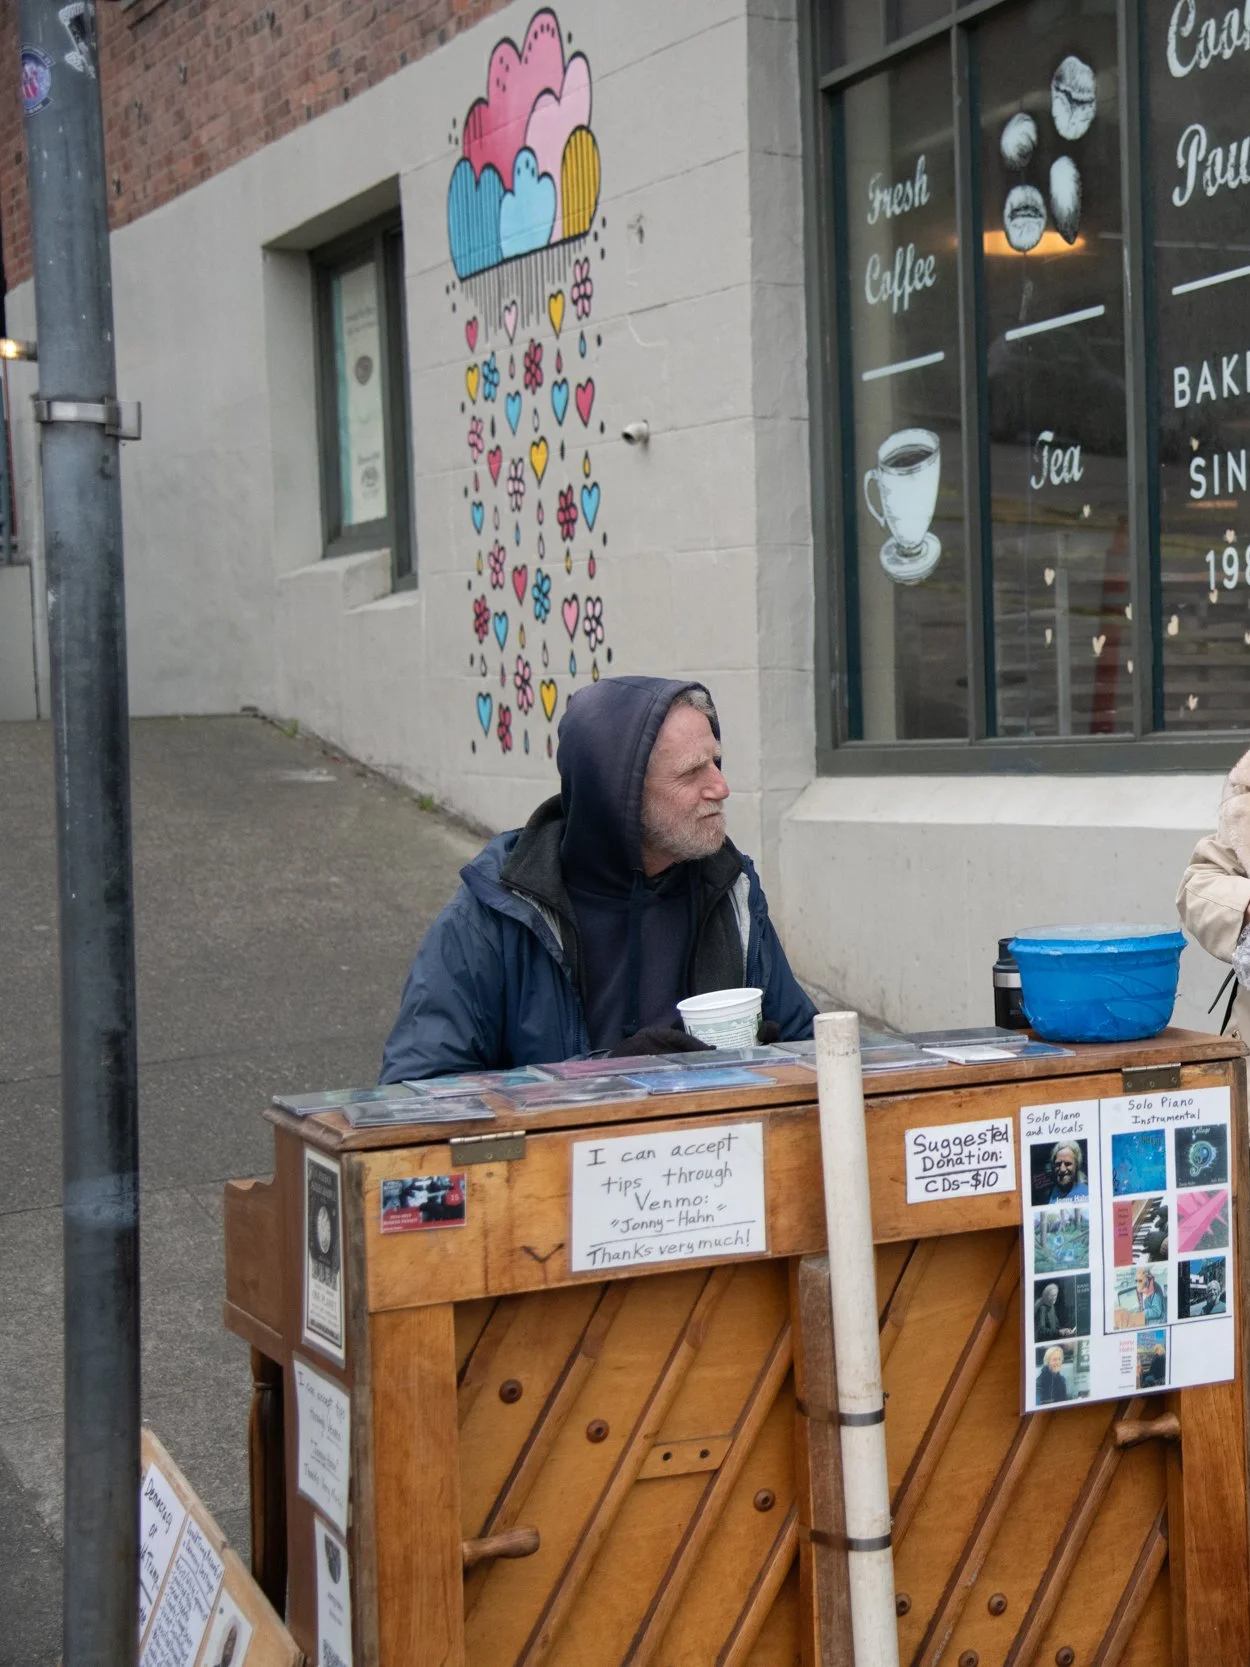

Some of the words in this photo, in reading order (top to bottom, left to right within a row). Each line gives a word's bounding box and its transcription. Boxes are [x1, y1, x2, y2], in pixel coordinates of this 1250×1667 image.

[867, 154, 930, 225] Fresh
[865, 243, 936, 313] Coffee
[1029, 430, 1083, 490] Tea
[1026, 1112, 1050, 1124] Solo
[1055, 1109, 1081, 1121] Piano
[1128, 1098, 1153, 1111] Solo
[1161, 1096, 1194, 1108] Piano
[1132, 1109, 1200, 1125] Instrumental
[913, 1123, 1009, 1159] Suggested
[1026, 1126, 1043, 1137] and
[1049, 1120, 1083, 1134] Vocals
[587, 1148, 606, 1167] I
[621, 1149, 656, 1162] can
[671, 1133, 739, 1161] accept
[922, 1147, 1002, 1172] Donation:
[601, 1174, 643, 1197] tips
[662, 1162, 733, 1188] through
[635, 1189, 709, 1212] Venmo:
[587, 1245, 651, 1266] Thanks
[659, 1241, 694, 1257] very
[698, 1229, 751, 1249] much!
